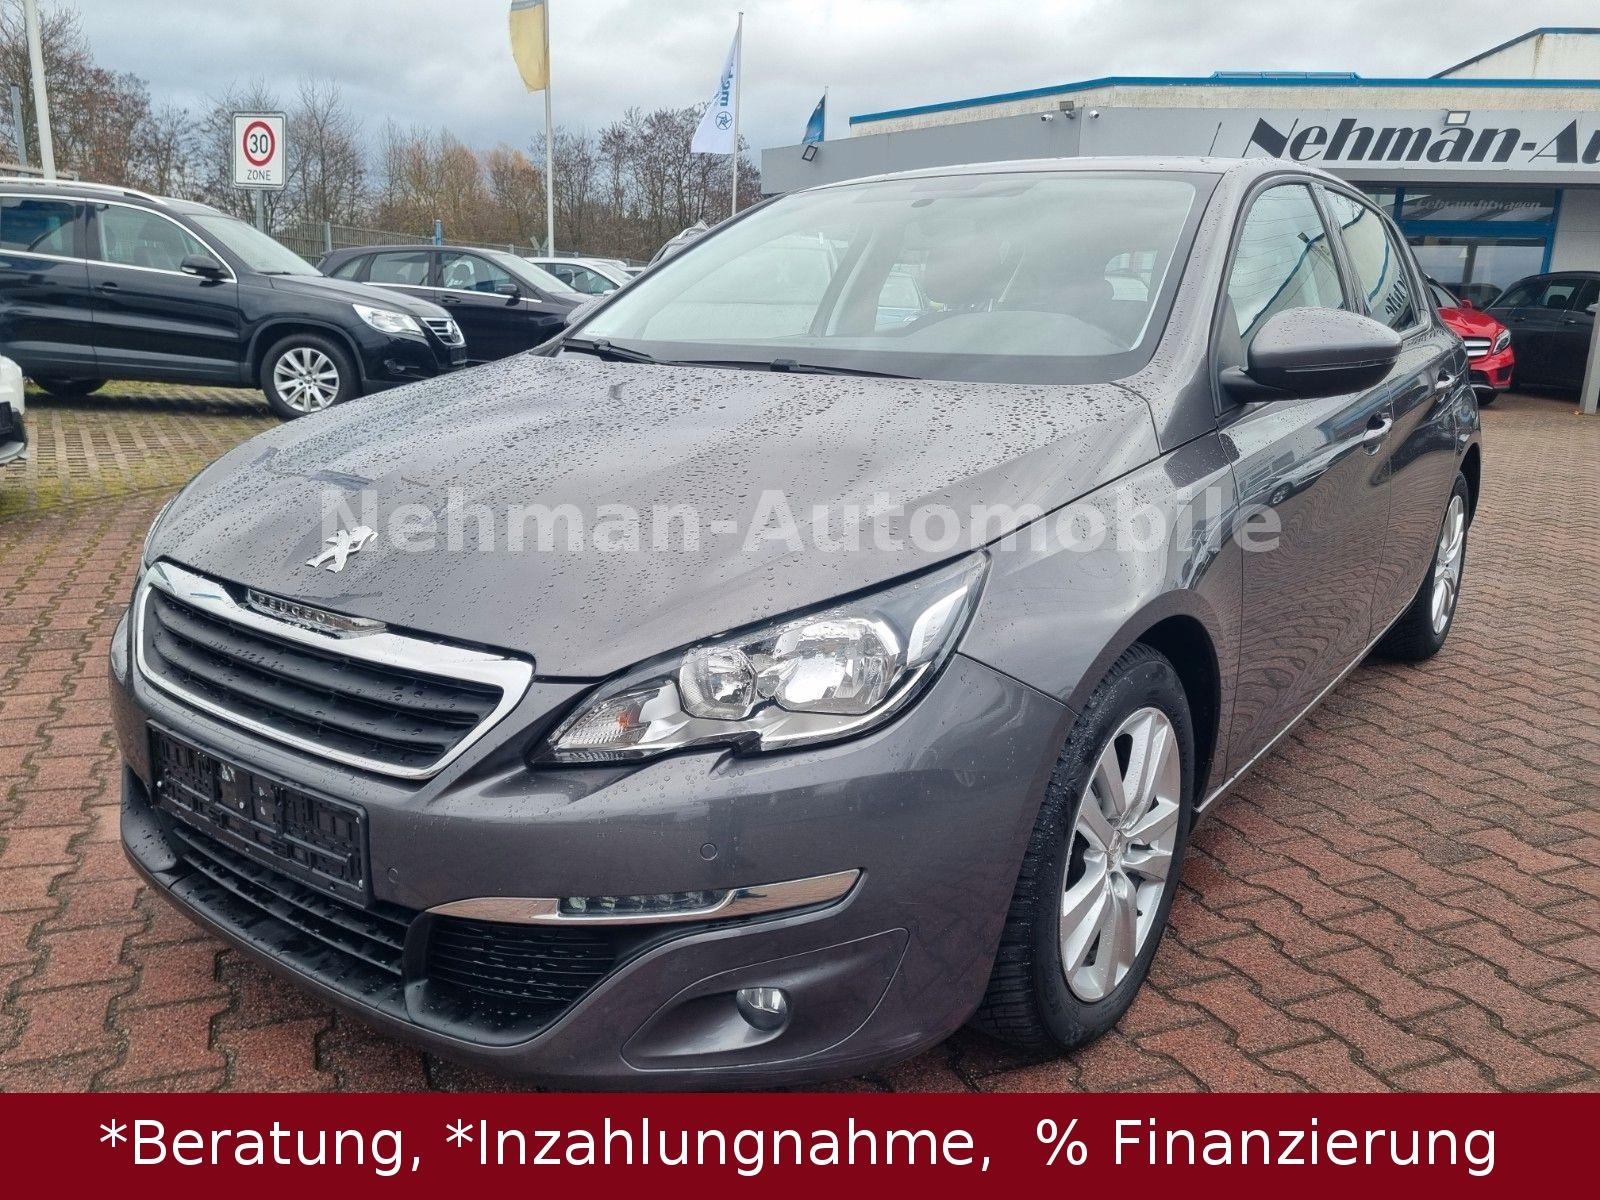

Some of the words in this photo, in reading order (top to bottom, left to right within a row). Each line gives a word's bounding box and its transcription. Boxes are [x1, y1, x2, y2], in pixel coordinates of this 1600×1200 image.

[250, 134, 268, 154] 30
[247, 169, 271, 181] ZONE
[258, 594, 338, 625] PEUGEO
